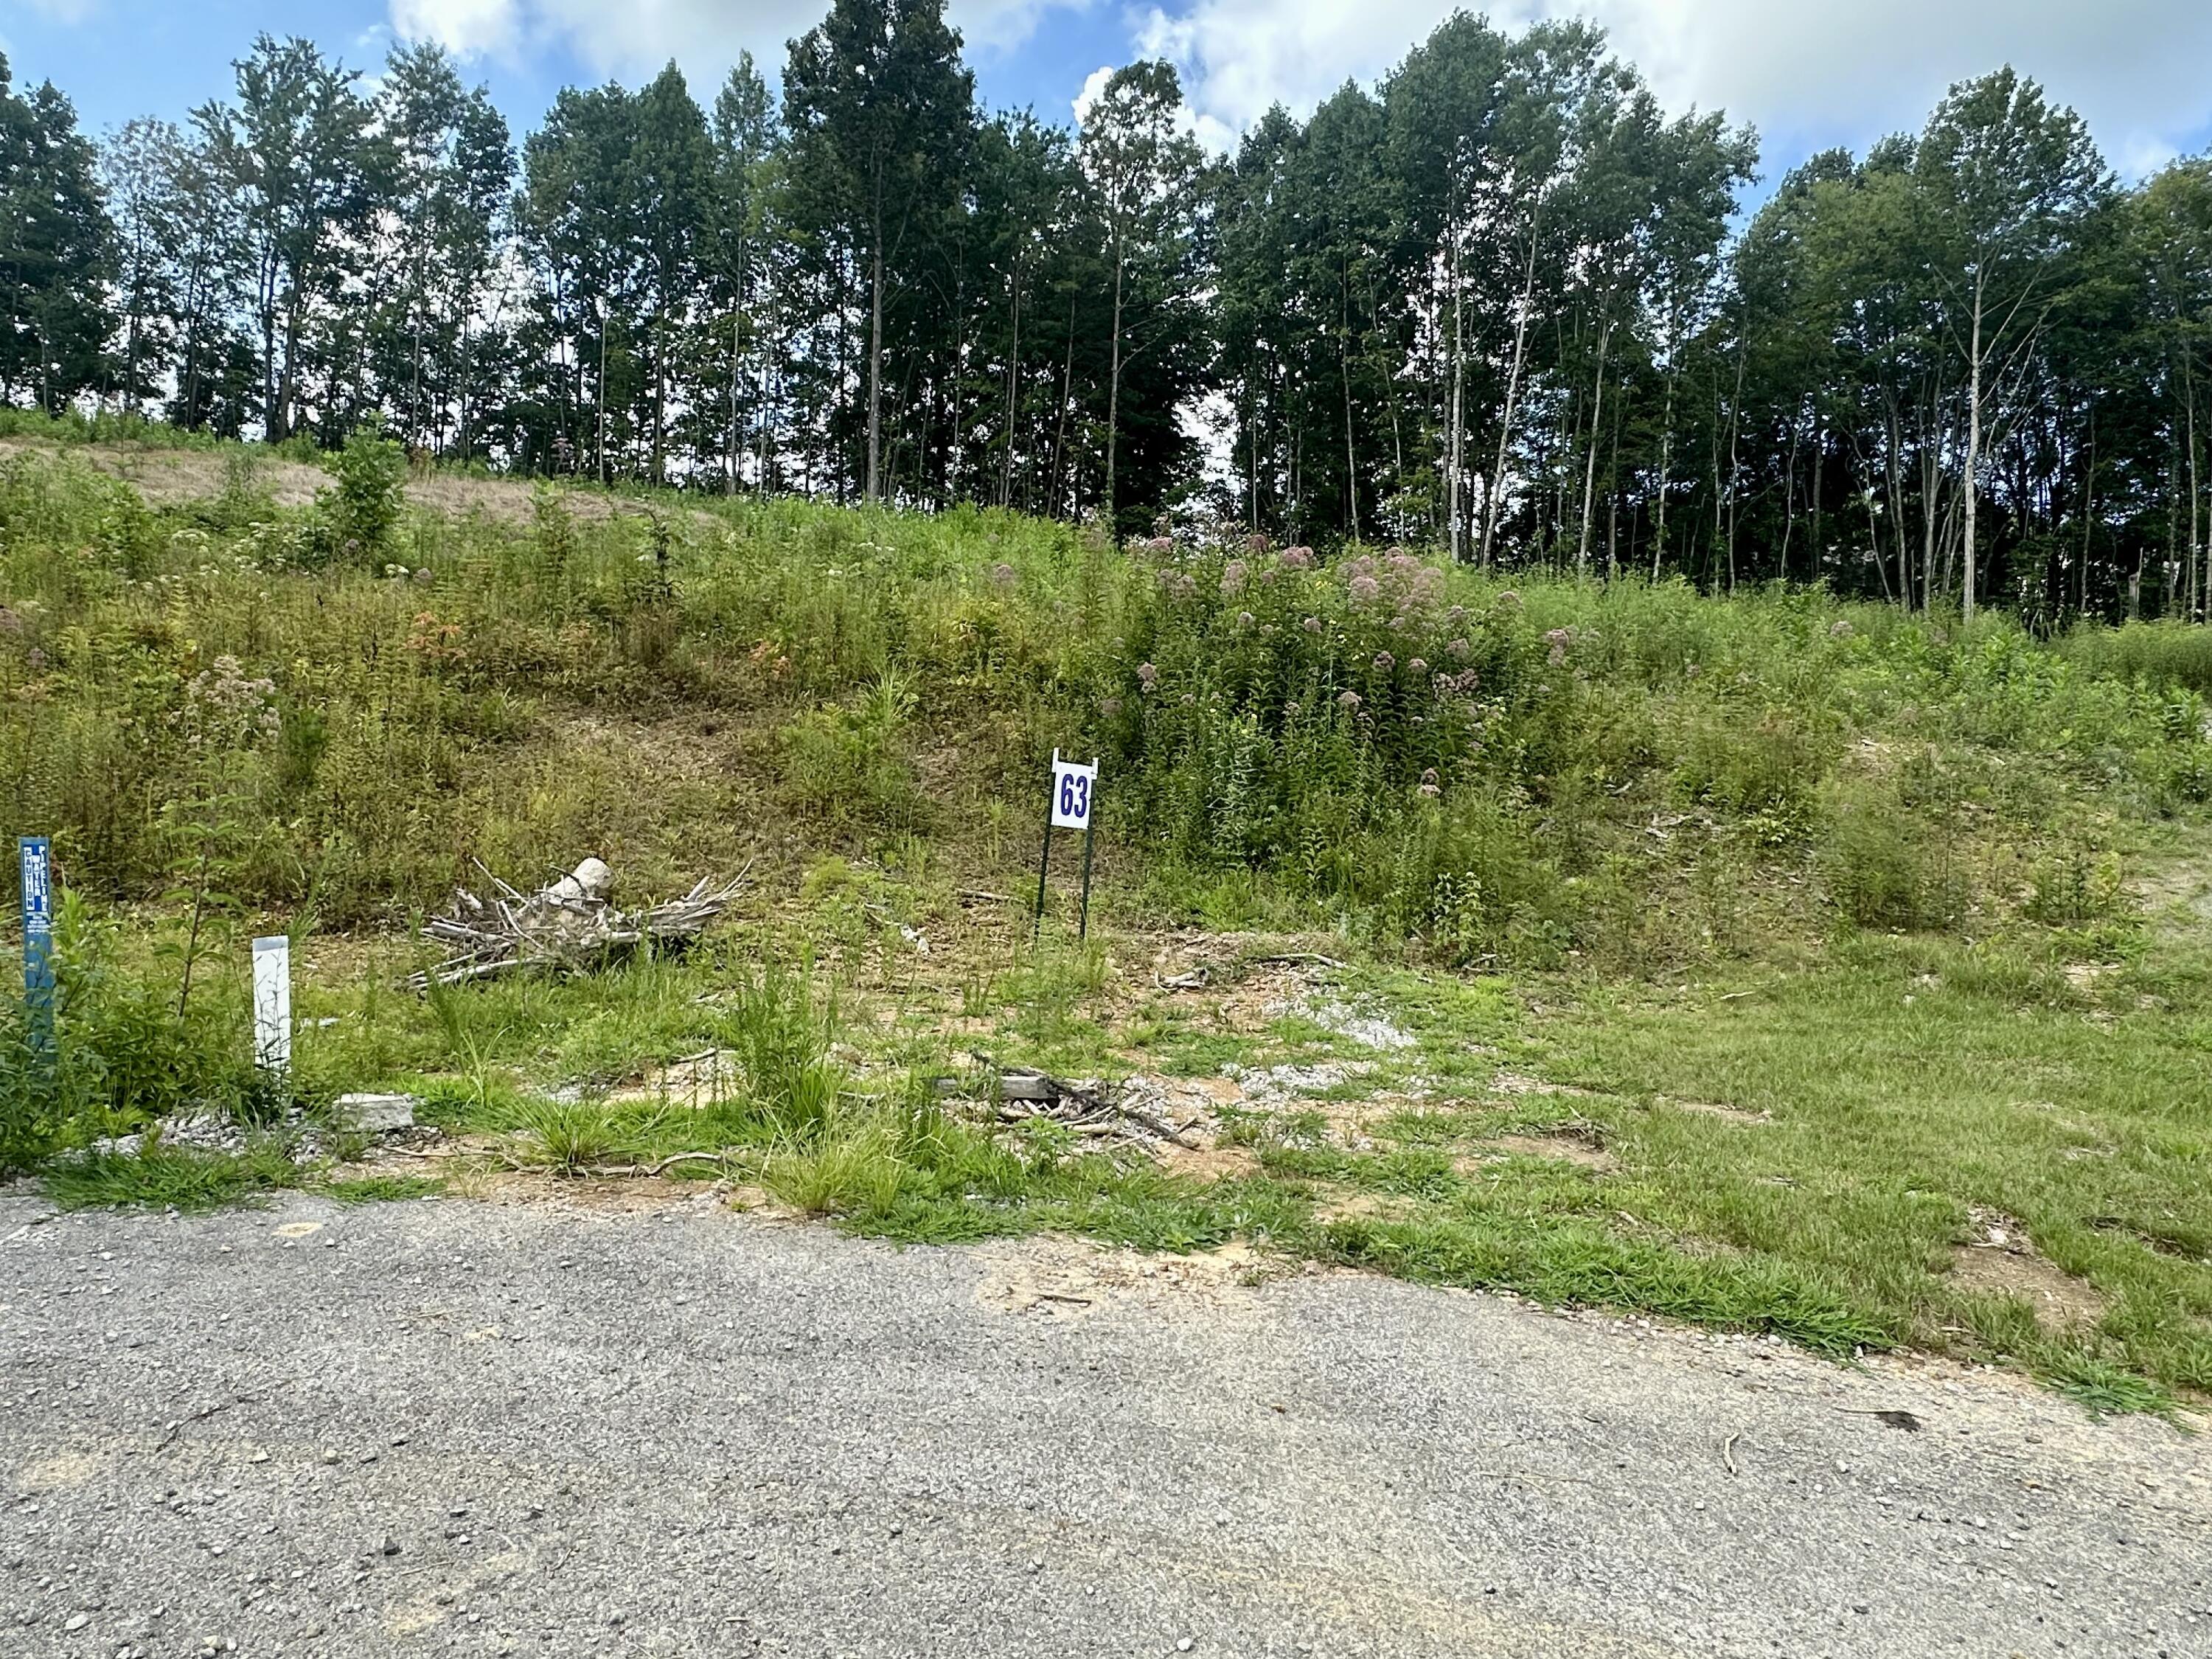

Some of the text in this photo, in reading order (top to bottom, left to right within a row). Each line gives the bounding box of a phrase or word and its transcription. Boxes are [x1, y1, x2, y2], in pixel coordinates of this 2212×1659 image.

[1060, 773, 1088, 818] 63
[25, 849, 34, 908] CAUTION
[32, 855, 41, 897] WATER
[38, 845, 48, 911] PIPELINE
